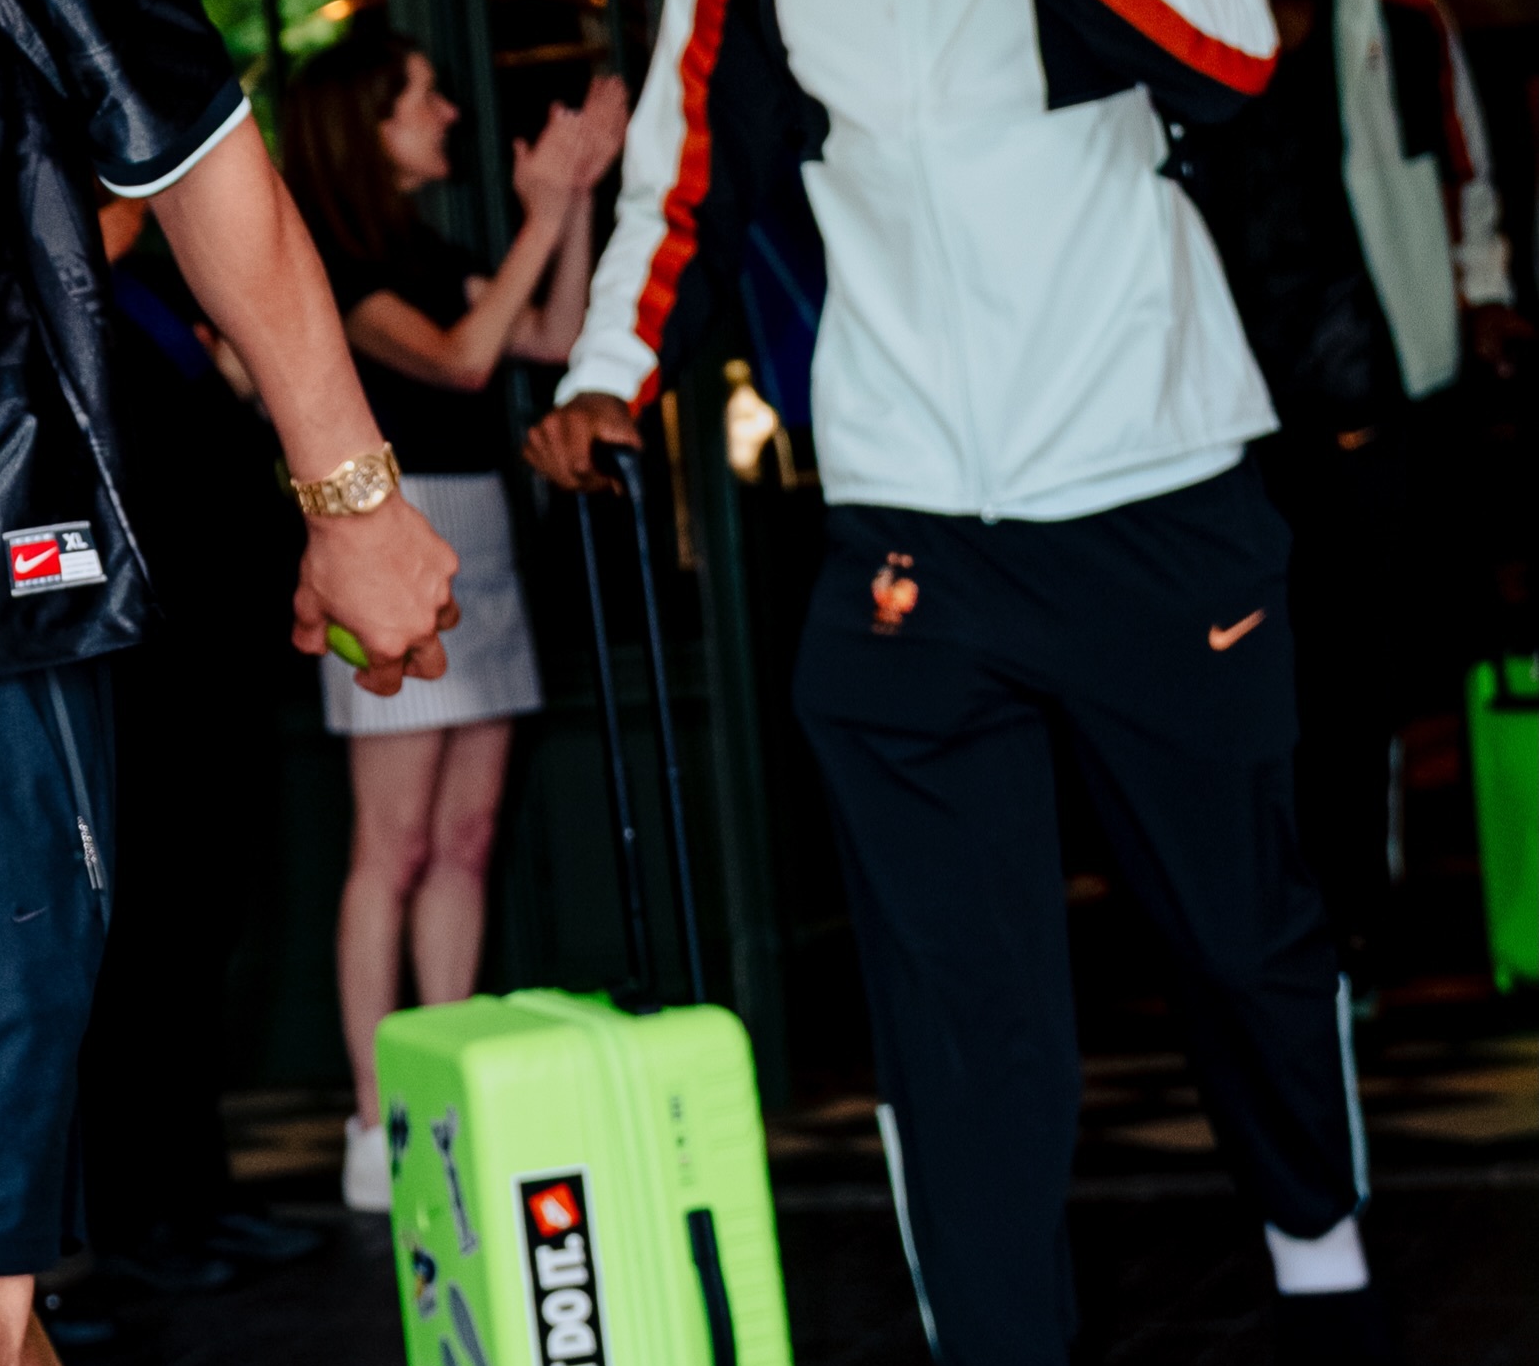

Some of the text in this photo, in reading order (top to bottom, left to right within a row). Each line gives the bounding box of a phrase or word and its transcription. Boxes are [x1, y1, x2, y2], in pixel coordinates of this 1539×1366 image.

[62, 532, 89, 551] XL
[535, 1232, 590, 1291] IT.
[541, 1288, 597, 1360] DO
